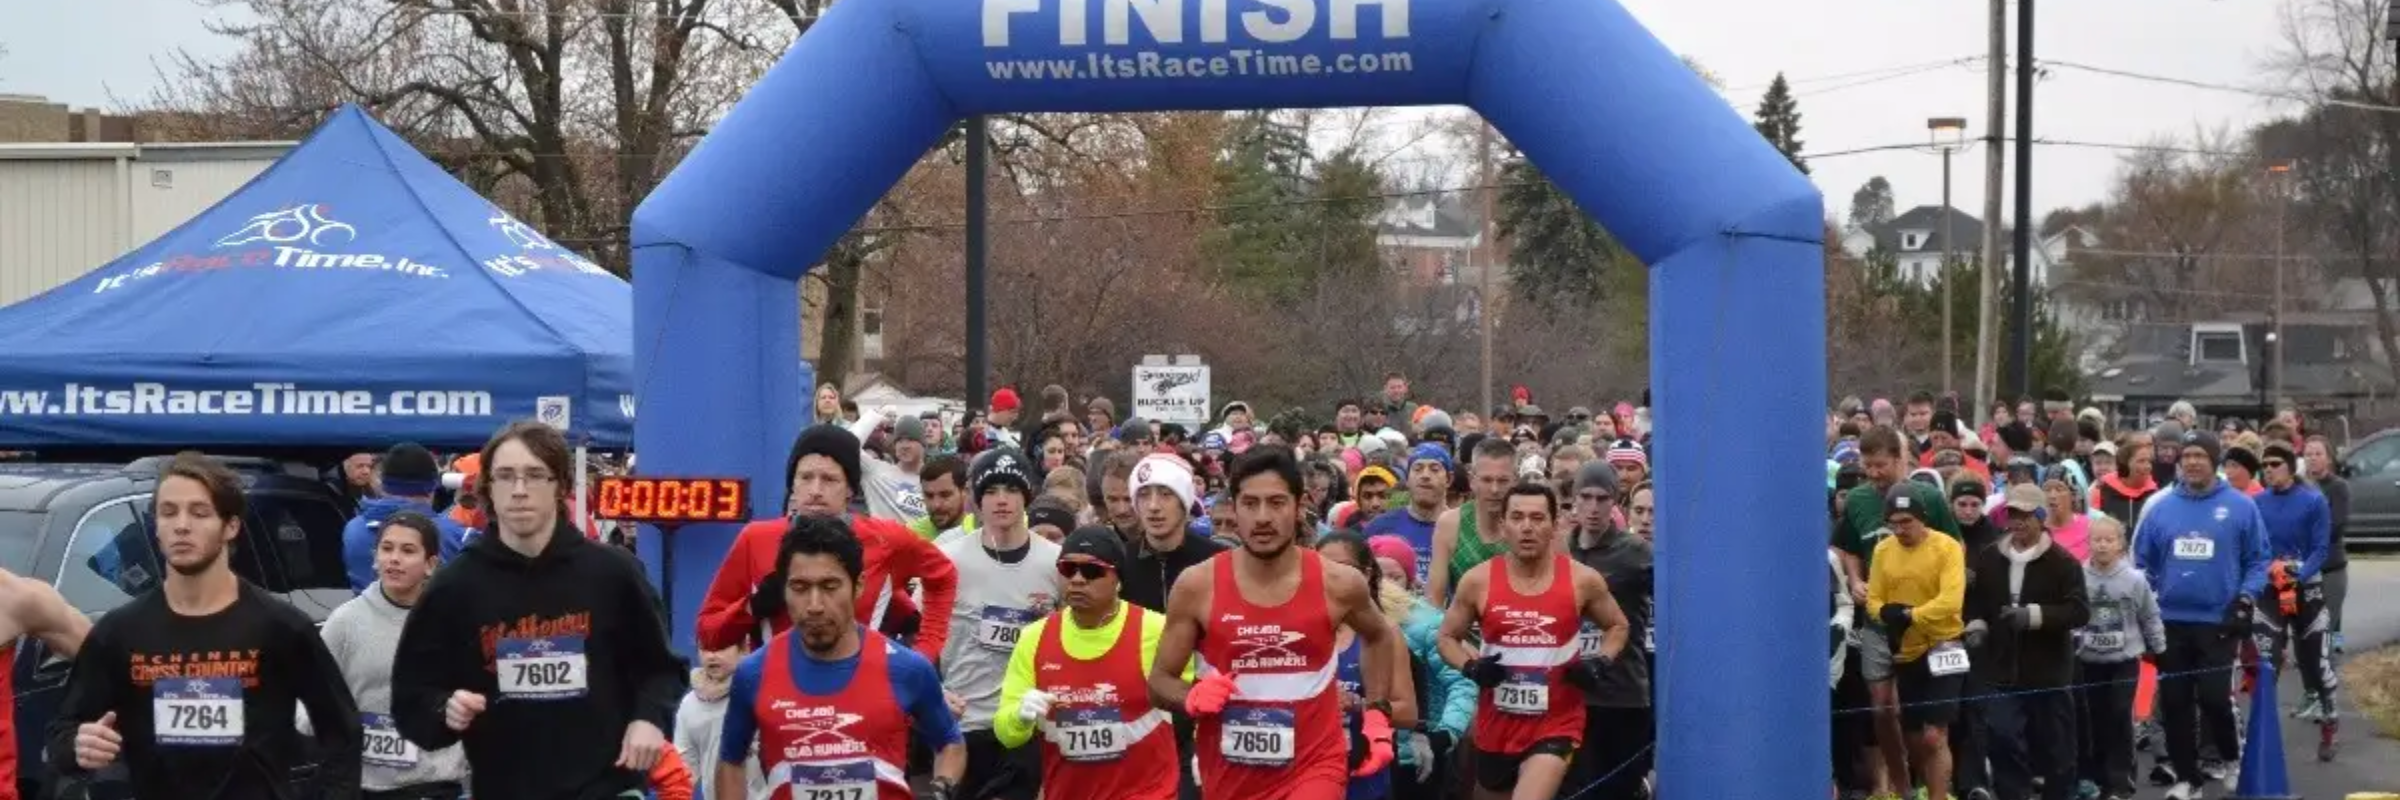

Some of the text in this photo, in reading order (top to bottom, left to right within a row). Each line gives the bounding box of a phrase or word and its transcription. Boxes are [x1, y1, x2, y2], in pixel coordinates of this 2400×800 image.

[986, 49, 1413, 79] www.ItsRaceTime.com
[0, 382, 491, 415] w.ItsRaceTime.com
[600, 480, 740, 518] 0:00:03
[1237, 625, 1281, 636] CHICAGO
[131, 661, 257, 681] CROSS COUNTRY
[512, 661, 573, 686] 7602
[1501, 687, 1539, 706] 7315
[168, 705, 228, 730] 7264
[785, 706, 835, 719] CHICAGO
[361, 734, 405, 756] 7320
[1066, 728, 1113, 750] 7149
[1231, 731, 1281, 753] 7650
